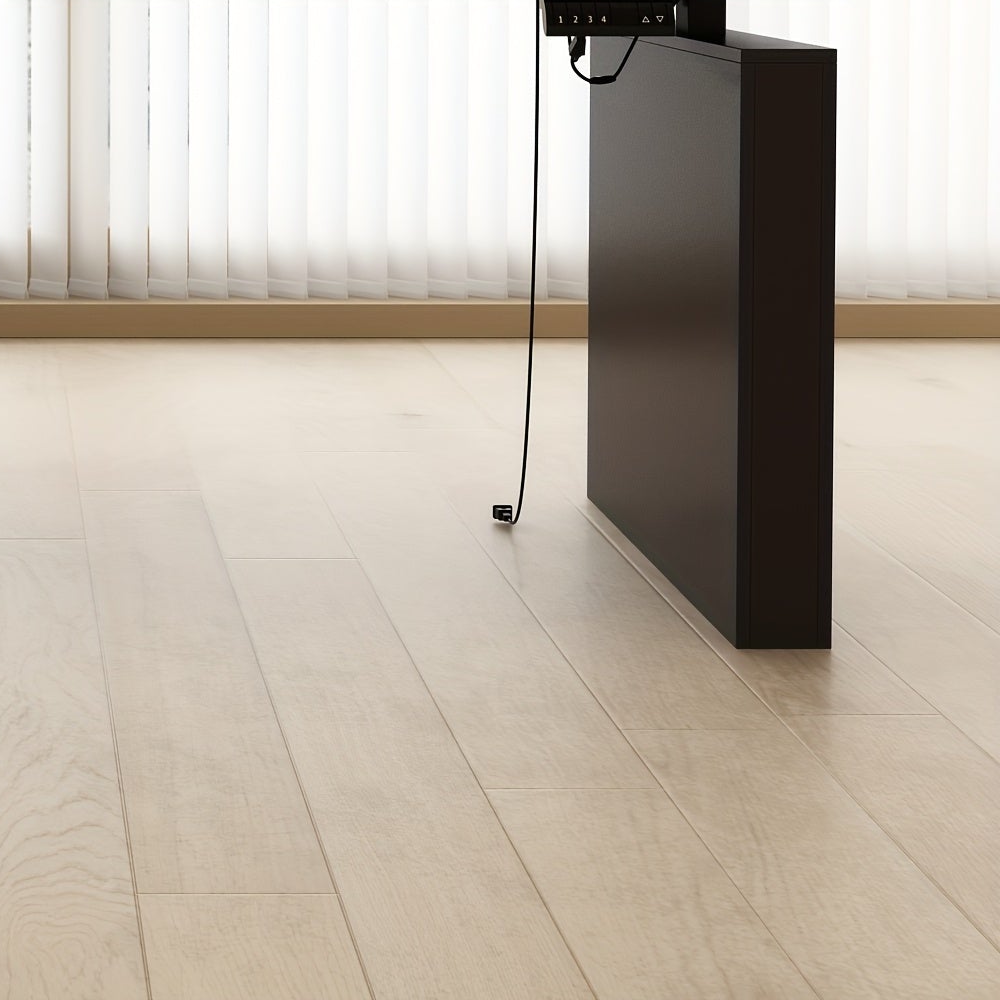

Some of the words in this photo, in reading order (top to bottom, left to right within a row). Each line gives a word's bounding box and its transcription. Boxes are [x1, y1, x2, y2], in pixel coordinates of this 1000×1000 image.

[558, 15, 563, 24] 1
[573, 15, 578, 24] 2
[587, 15, 593, 24] 3
[601, 15, 607, 23] 4
